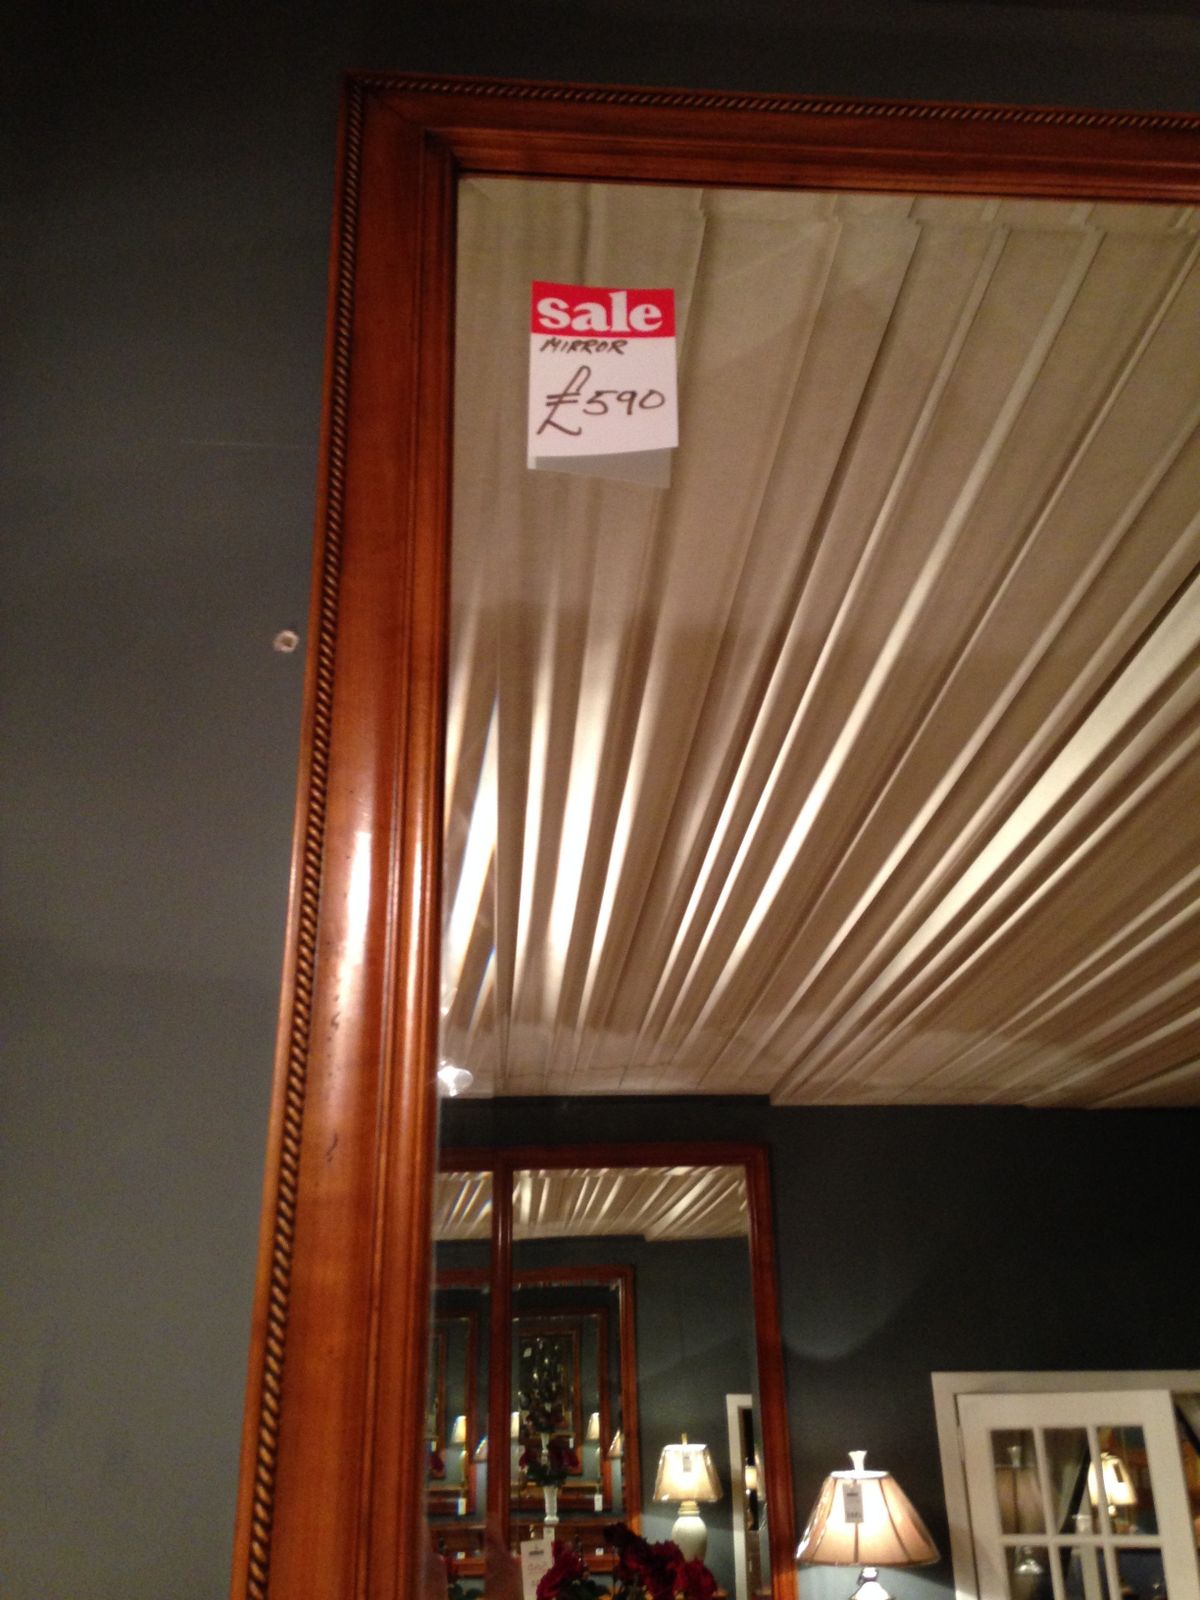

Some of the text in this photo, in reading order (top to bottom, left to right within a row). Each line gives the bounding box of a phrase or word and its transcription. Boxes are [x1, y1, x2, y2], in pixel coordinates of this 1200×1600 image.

[536, 290, 663, 332] sale
[540, 337, 628, 355] MIRROR
[536, 365, 665, 436] £590
